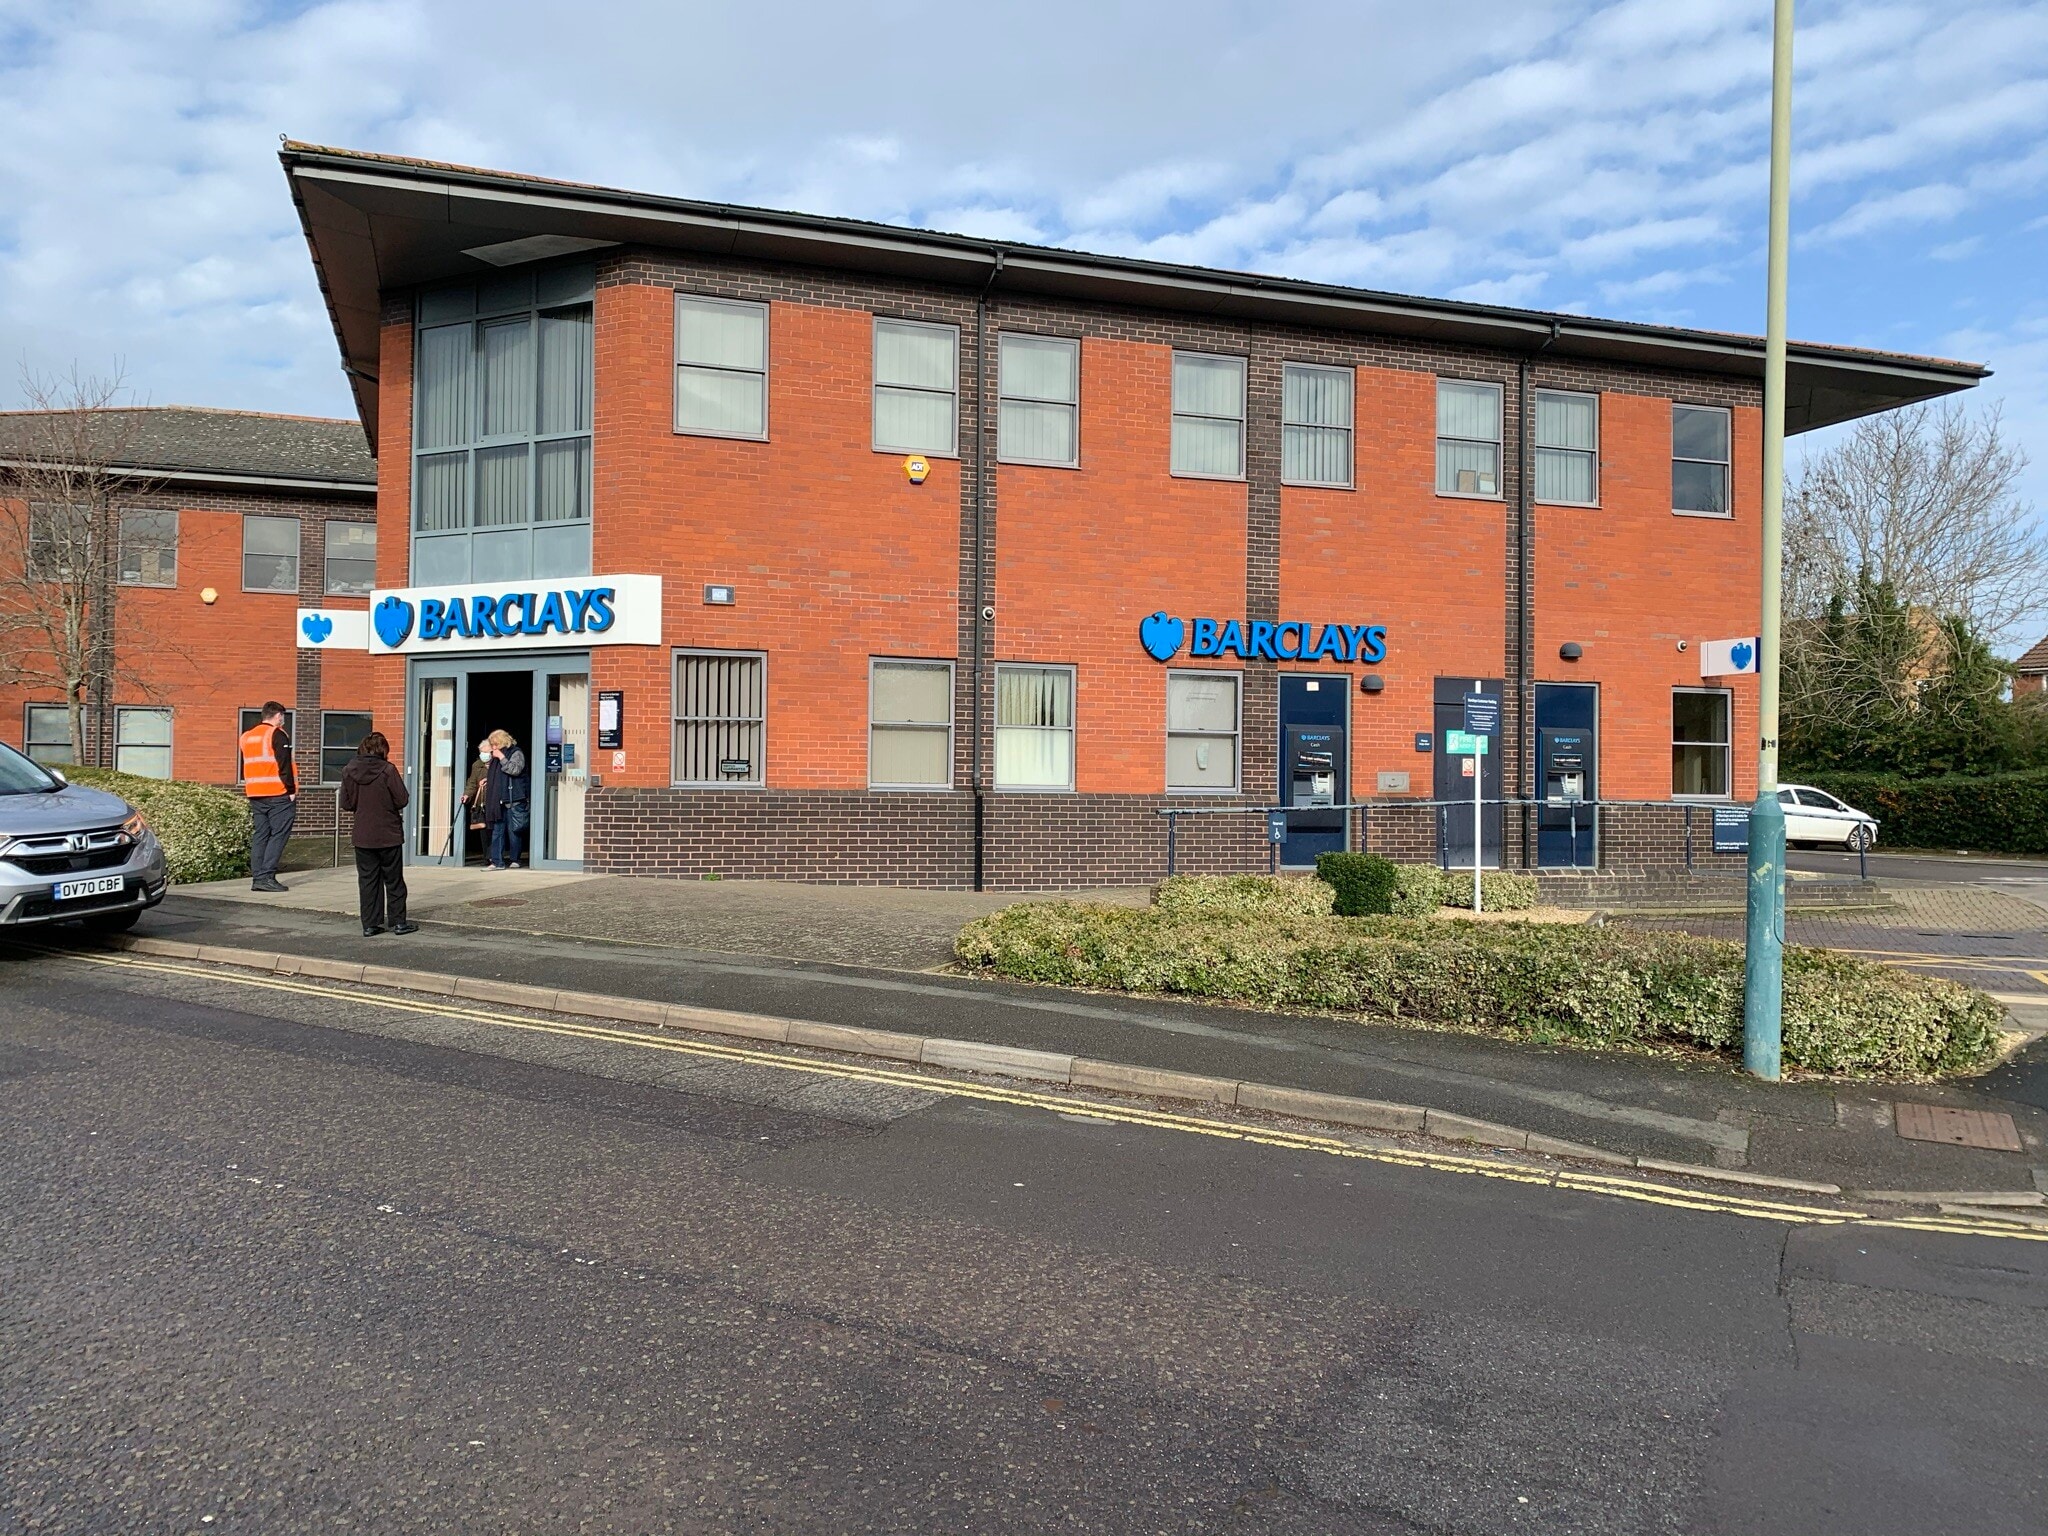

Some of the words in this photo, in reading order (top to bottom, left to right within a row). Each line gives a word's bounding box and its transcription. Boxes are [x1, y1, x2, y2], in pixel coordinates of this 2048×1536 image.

[911, 462, 924, 471] ADT
[418, 588, 616, 639] BARCLAYS
[1190, 618, 1387, 663] BARCLAYS
[62, 881, 95, 897] OV70
[98, 878, 121, 892] CBF
